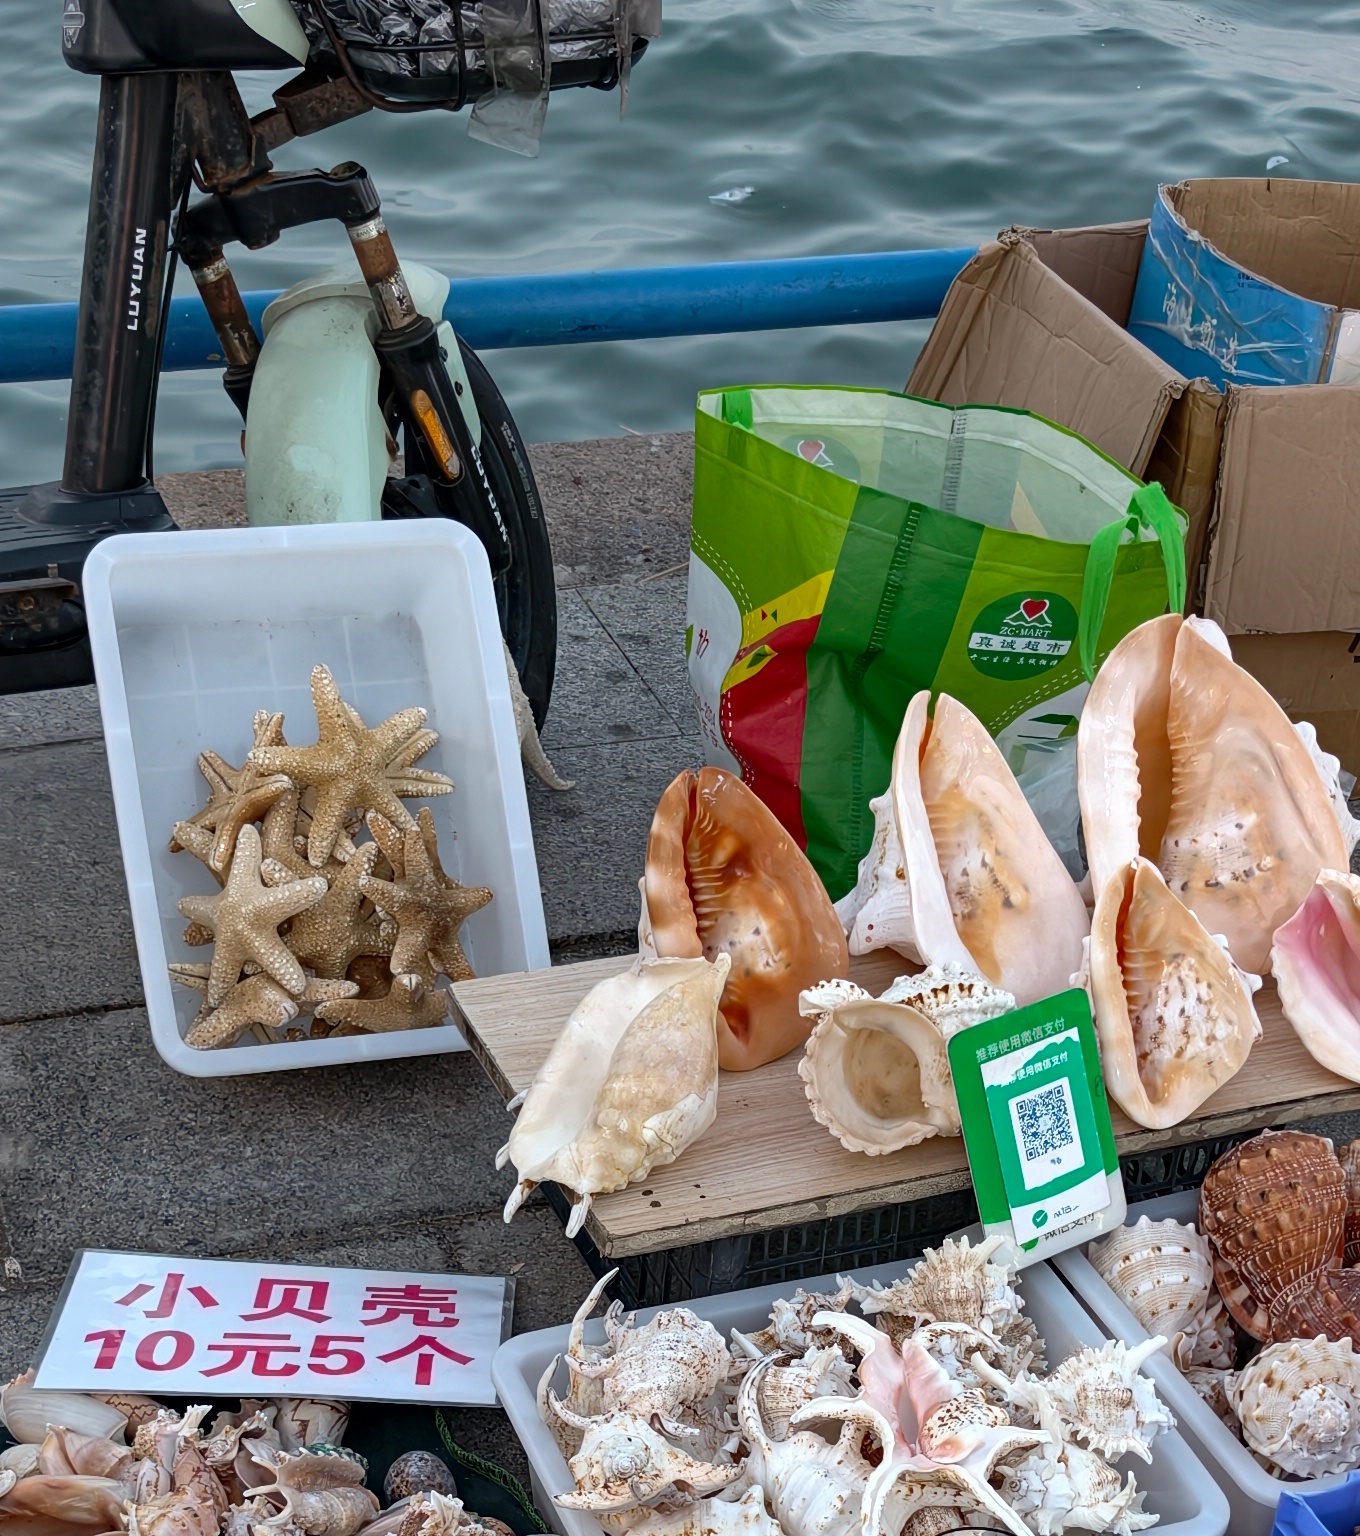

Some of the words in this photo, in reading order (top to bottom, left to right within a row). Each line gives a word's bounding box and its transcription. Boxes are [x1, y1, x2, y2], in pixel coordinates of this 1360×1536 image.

[127, 228, 147, 331] LUYUAN
[975, 636, 1065, 654] 真诚超市
[976, 1016, 1065, 1063] 推荐使用微信支付
[115, 1272, 460, 1328] 小贝壳
[83, 1329, 475, 1386] 10元5个
